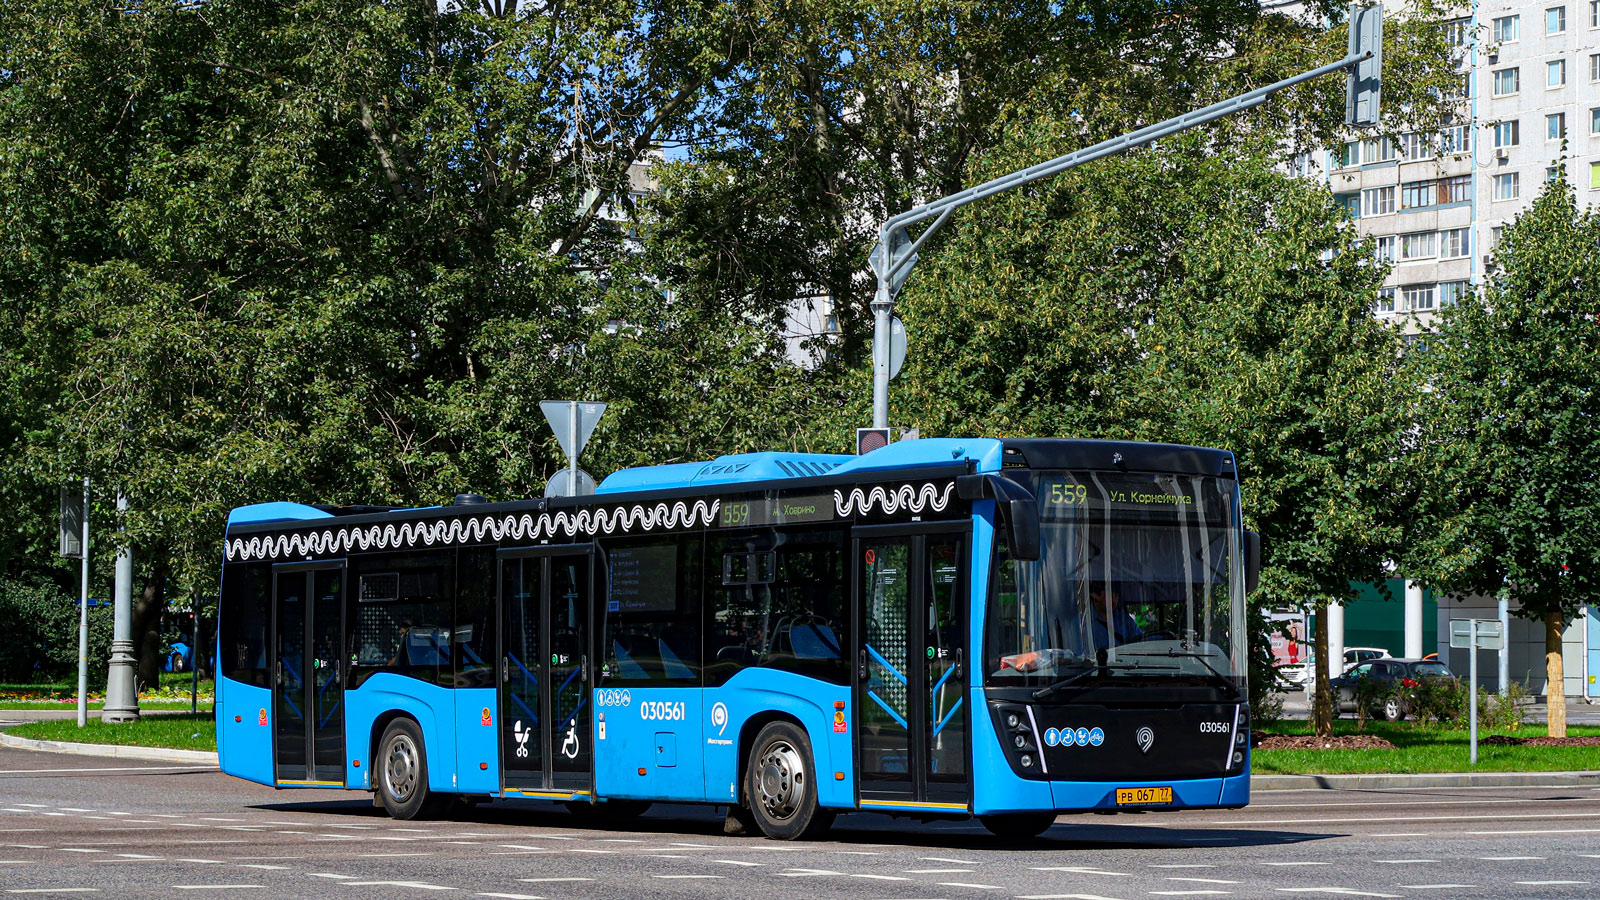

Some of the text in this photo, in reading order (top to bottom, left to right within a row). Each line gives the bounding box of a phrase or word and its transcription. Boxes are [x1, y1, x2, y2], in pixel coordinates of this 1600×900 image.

[1051, 484, 1087, 505] 559
[1110, 490, 1192, 506] Ул. Корнейчука
[723, 503, 749, 524] 559
[783, 504, 816, 517] Ховрино
[640, 701, 685, 720] 030561
[1200, 721, 1230, 733] 030561
[1136, 789, 1155, 801] 067
[1160, 788, 1169, 798] 77
